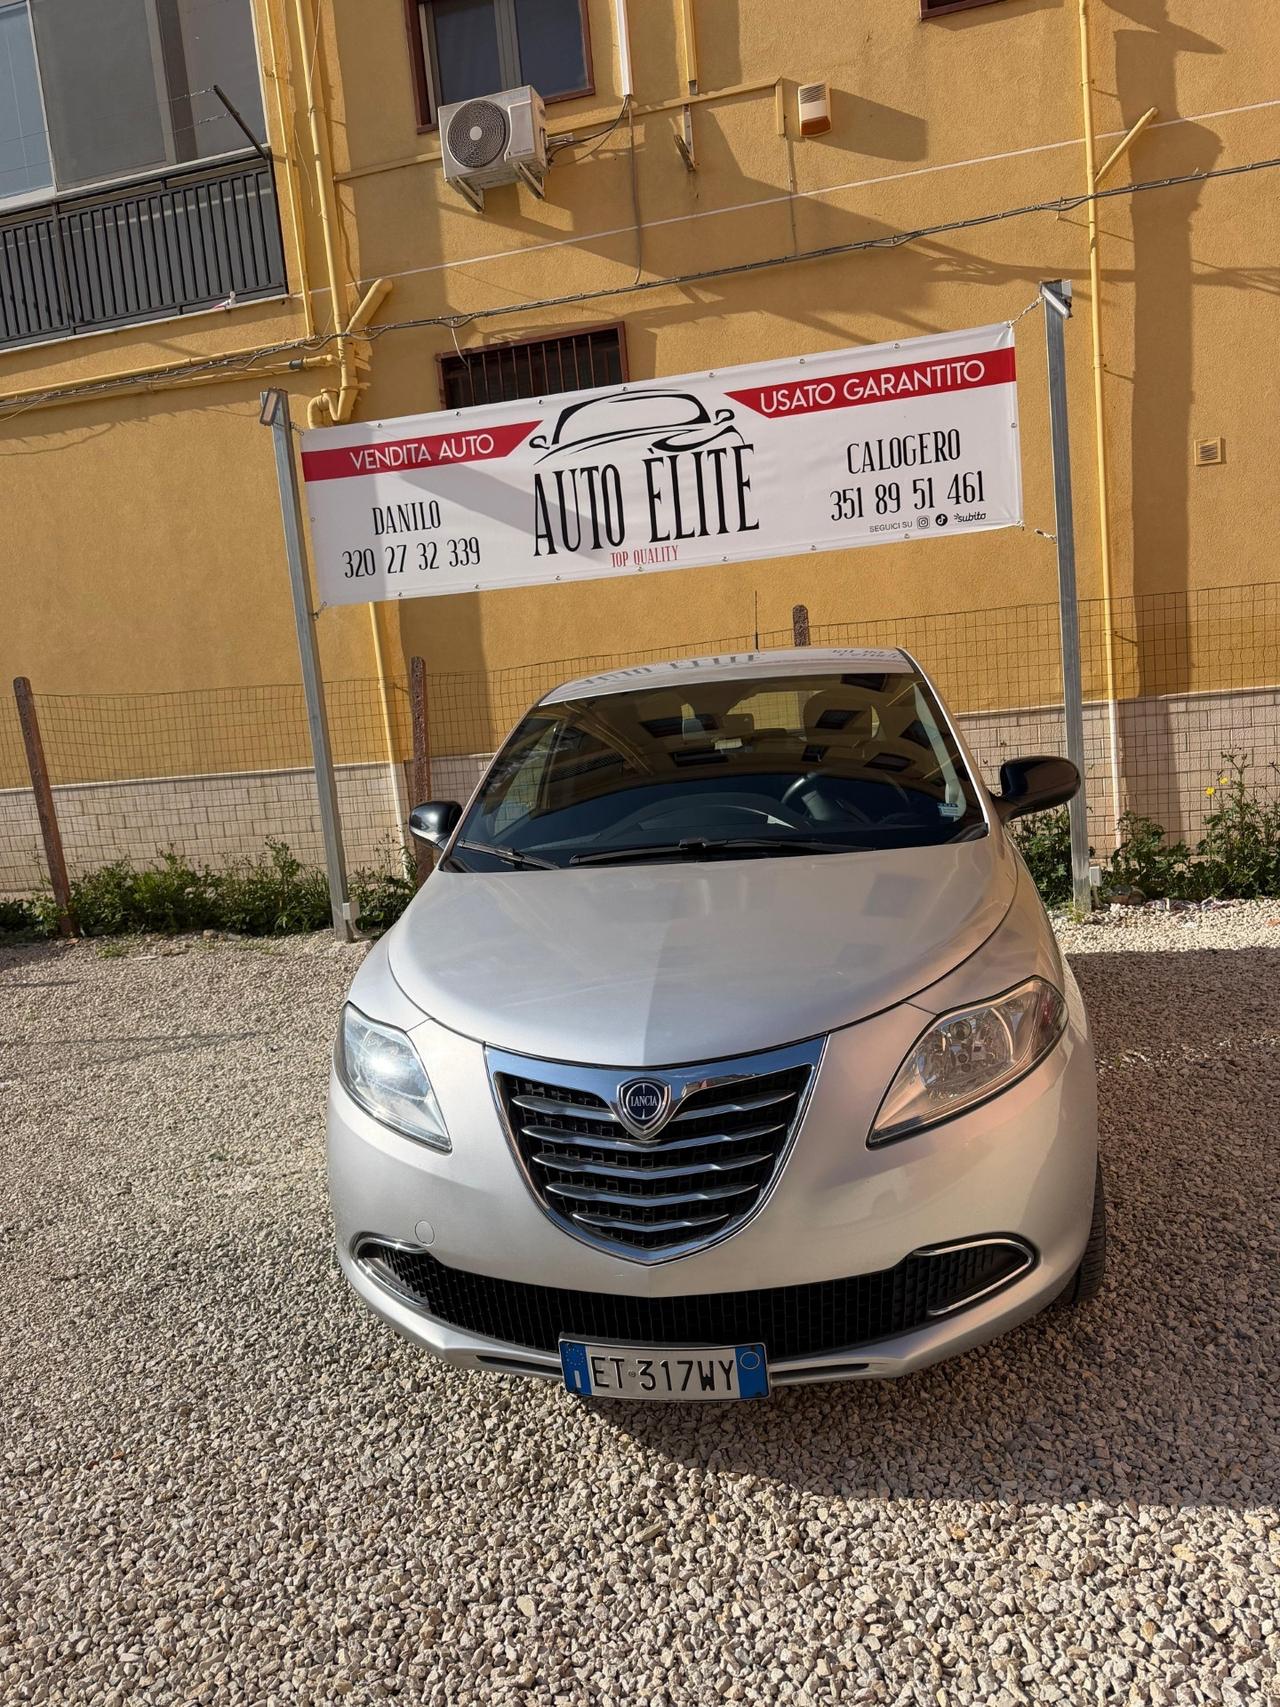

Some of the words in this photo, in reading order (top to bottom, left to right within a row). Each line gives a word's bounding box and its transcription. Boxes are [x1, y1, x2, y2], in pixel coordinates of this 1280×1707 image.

[760, 382, 836, 413] USATO
[843, 359, 985, 401] GARANTITO
[350, 443, 431, 471] VENDITA
[438, 433, 495, 460] AUTO
[846, 428, 961, 474] CALOGERO
[533, 463, 626, 557] AUTO
[829, 486, 864, 521] 351
[875, 482, 901, 515] 89
[912, 477, 935, 510] 51
[947, 470, 984, 506] 461
[372, 500, 442, 536] DANILO
[869, 522, 901, 533] SEGUICI
[902, 520, 913, 529] SU
[957, 511, 987, 523] subito
[342, 548, 376, 578] 320
[385, 544, 407, 574] 27
[416, 541, 439, 570] 32
[447, 536, 481, 567] 339
[610, 551, 629, 568] TOP
[633, 545, 679, 566] QUALITY
[630, 1095, 658, 1107] LANCIA
